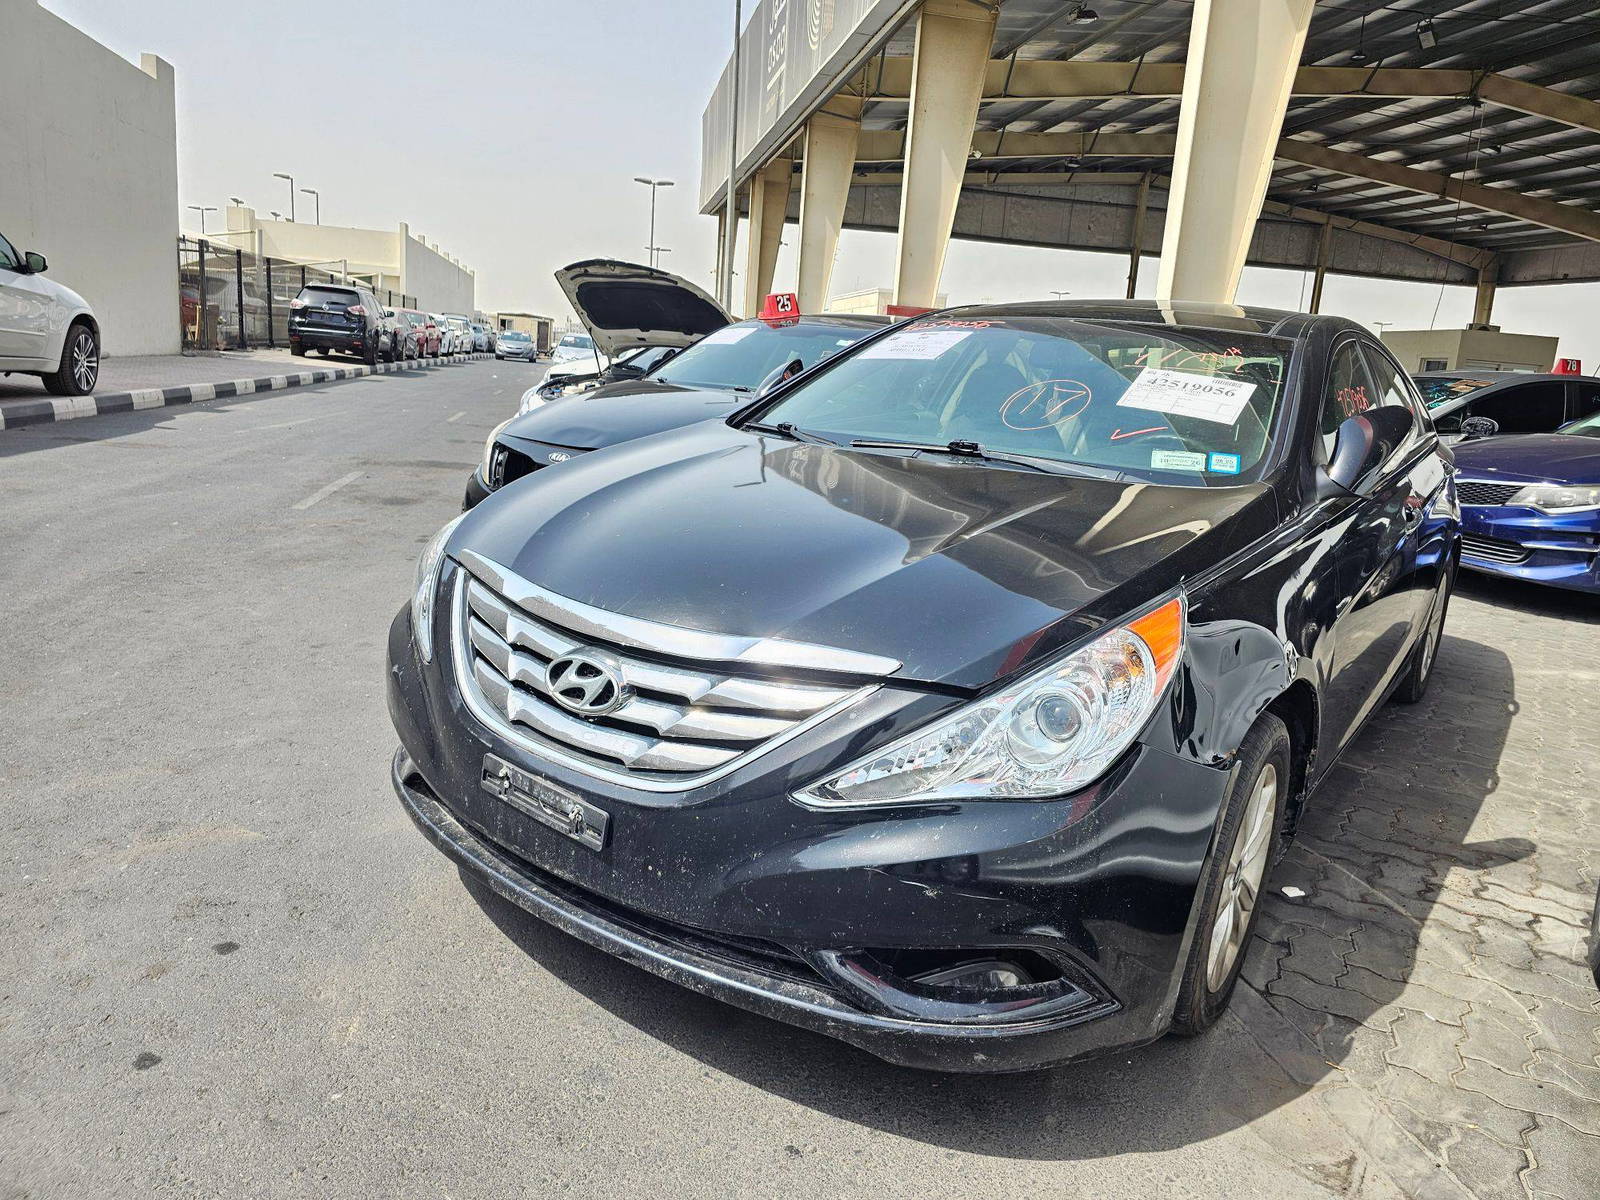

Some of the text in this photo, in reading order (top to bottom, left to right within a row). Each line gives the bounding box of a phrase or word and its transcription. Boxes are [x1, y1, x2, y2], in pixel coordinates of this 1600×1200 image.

[777, 295, 792, 312] 25
[1567, 359, 1577, 371] 78
[1147, 378, 1236, 398] 42519056
